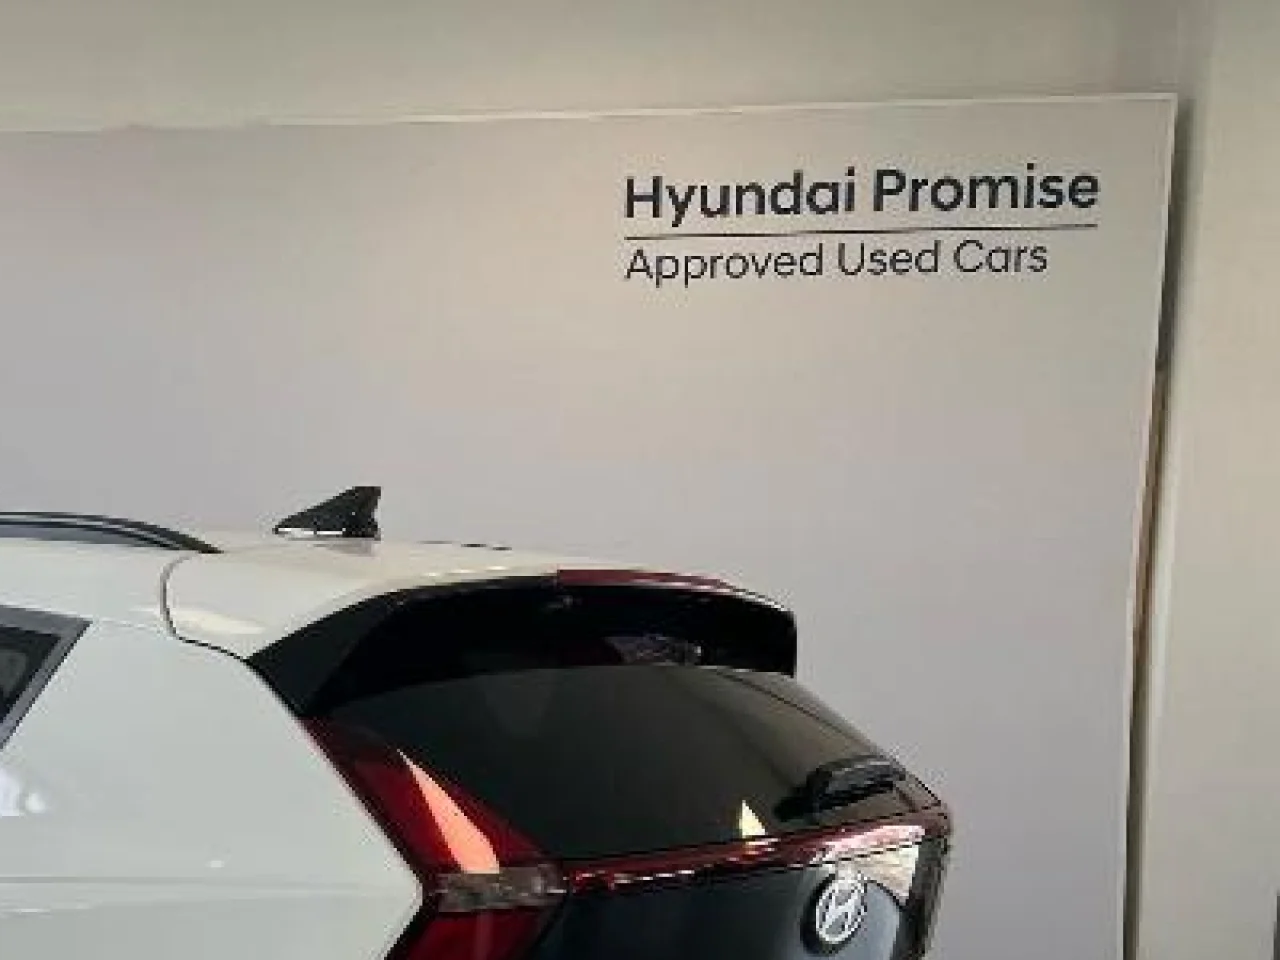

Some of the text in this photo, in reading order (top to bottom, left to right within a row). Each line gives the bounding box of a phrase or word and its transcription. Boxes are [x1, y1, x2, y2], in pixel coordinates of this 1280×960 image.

[625, 163, 1101, 227] Hyundai Promise
[625, 240, 1049, 288] Approved Used Cars
